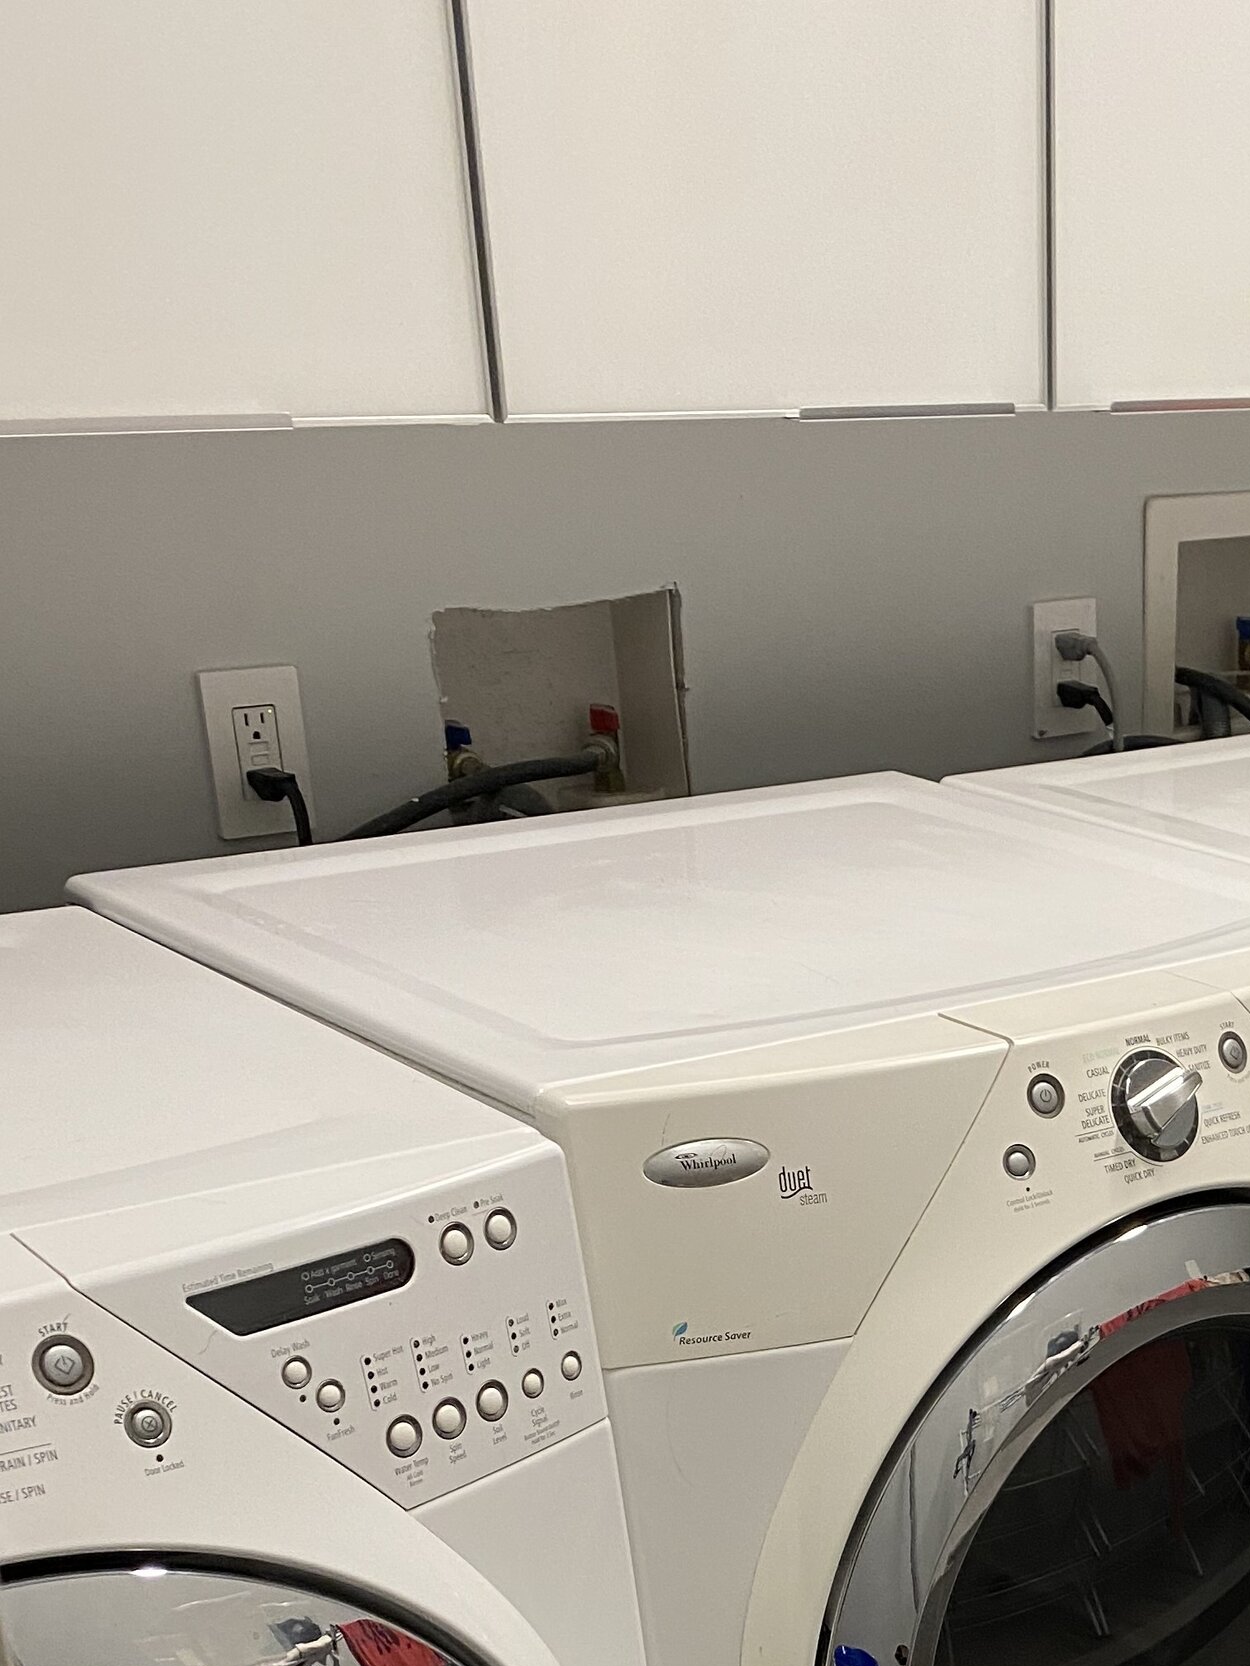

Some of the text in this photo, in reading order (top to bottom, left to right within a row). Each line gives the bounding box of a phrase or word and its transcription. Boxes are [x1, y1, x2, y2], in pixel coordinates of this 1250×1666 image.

[1125, 1034, 1152, 1046] NORMAL
[1156, 1035, 1174, 1046] BULKY
[1027, 1060, 1050, 1074] POWER
[1086, 1066, 1110, 1078] CASUAL
[1078, 1088, 1106, 1102] DELICATE
[1085, 1105, 1105, 1118] SUPER
[1082, 1114, 1110, 1130] DELICATE
[680, 1153, 738, 1173] Whirlpool
[1104, 1158, 1136, 1174] TIMED DRY
[778, 1165, 814, 1197] duet
[1124, 1168, 1156, 1184] QUICK DRY
[799, 1192, 828, 1206] steam
[38, 1322, 68, 1338] START
[678, 1330, 752, 1346] Resource Saver
[114, 1394, 134, 1424] PAUSE
[140, 1389, 178, 1413] CANCEL
[33, 1449, 58, 1464] SPIN
[21, 1484, 46, 1499] SPIN
